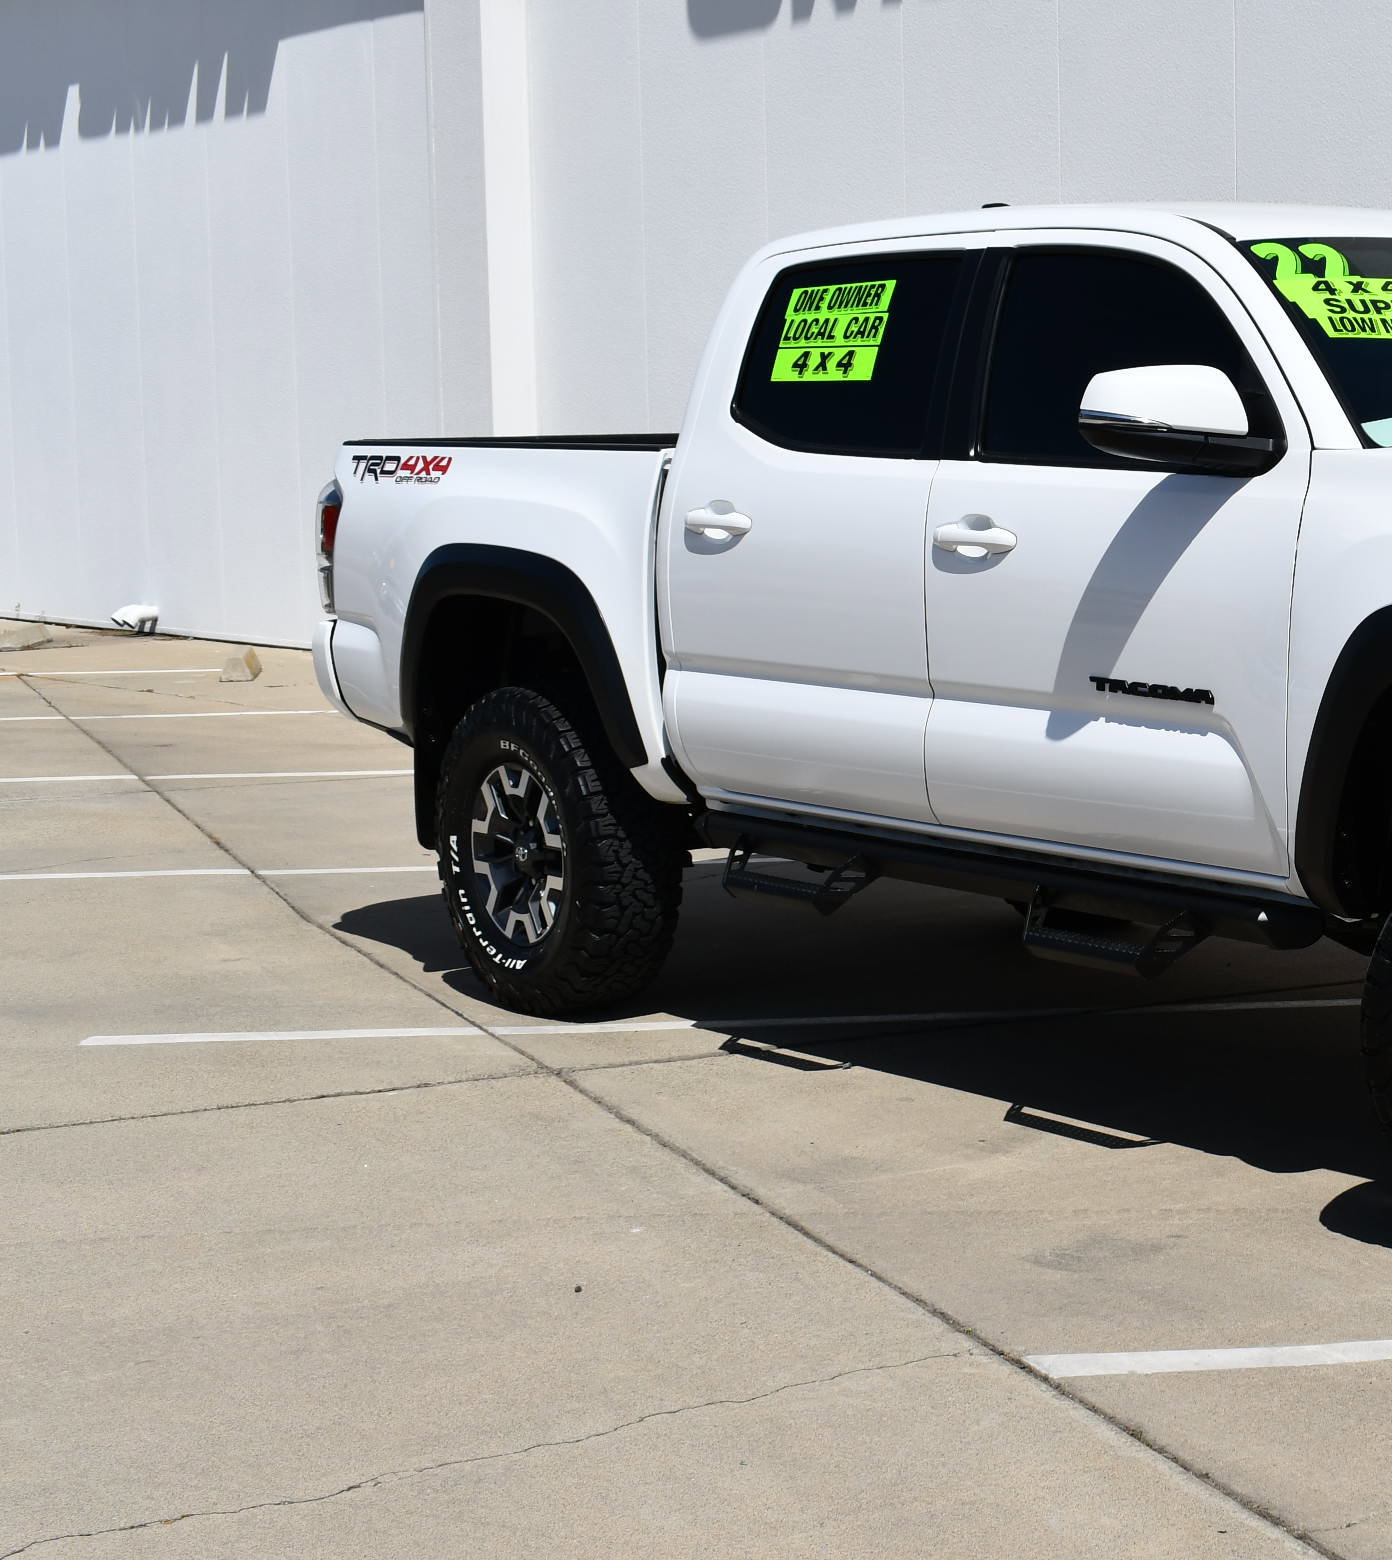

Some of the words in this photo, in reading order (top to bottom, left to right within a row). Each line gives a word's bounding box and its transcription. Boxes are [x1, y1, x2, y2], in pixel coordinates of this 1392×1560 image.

[793, 288, 830, 315] ONE
[826, 283, 887, 312] OWNER
[782, 317, 839, 343] LOCAL
[843, 315, 885, 343] CAR
[1327, 316, 1380, 336] LOW
[352, 455, 401, 482] TRD
[395, 476, 413, 484] OFF
[414, 476, 440, 484] ROAD
[1089, 676, 1215, 705] TACOMA
